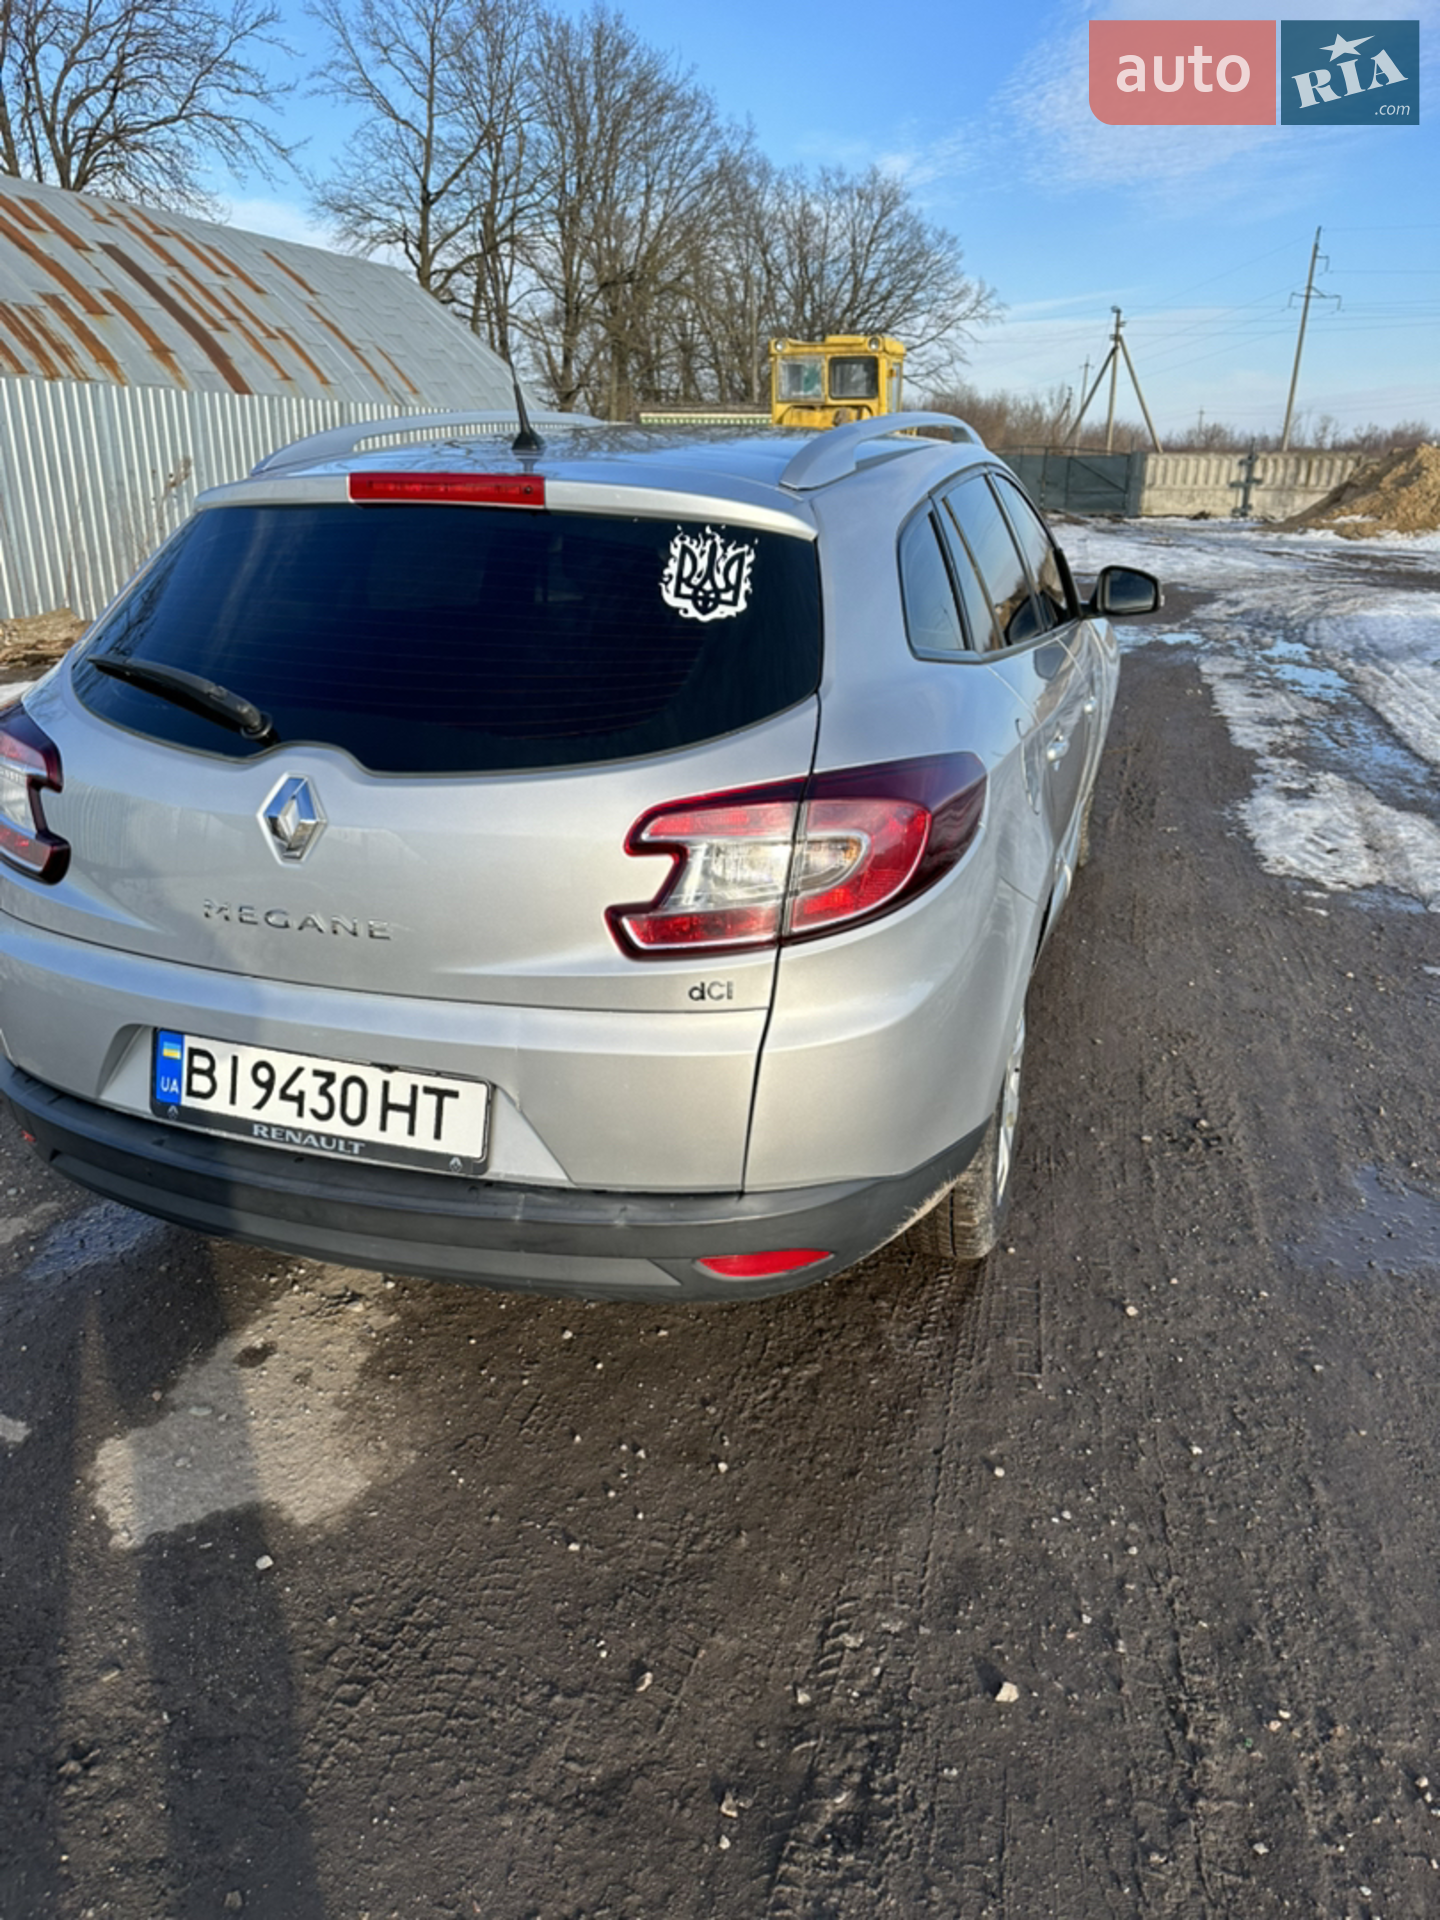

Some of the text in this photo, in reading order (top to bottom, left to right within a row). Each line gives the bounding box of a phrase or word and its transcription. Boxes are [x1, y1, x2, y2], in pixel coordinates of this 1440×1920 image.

[203, 899, 391, 940] MEGANE
[161, 1077, 179, 1095] UA
[252, 1123, 365, 1155] RENAULT
